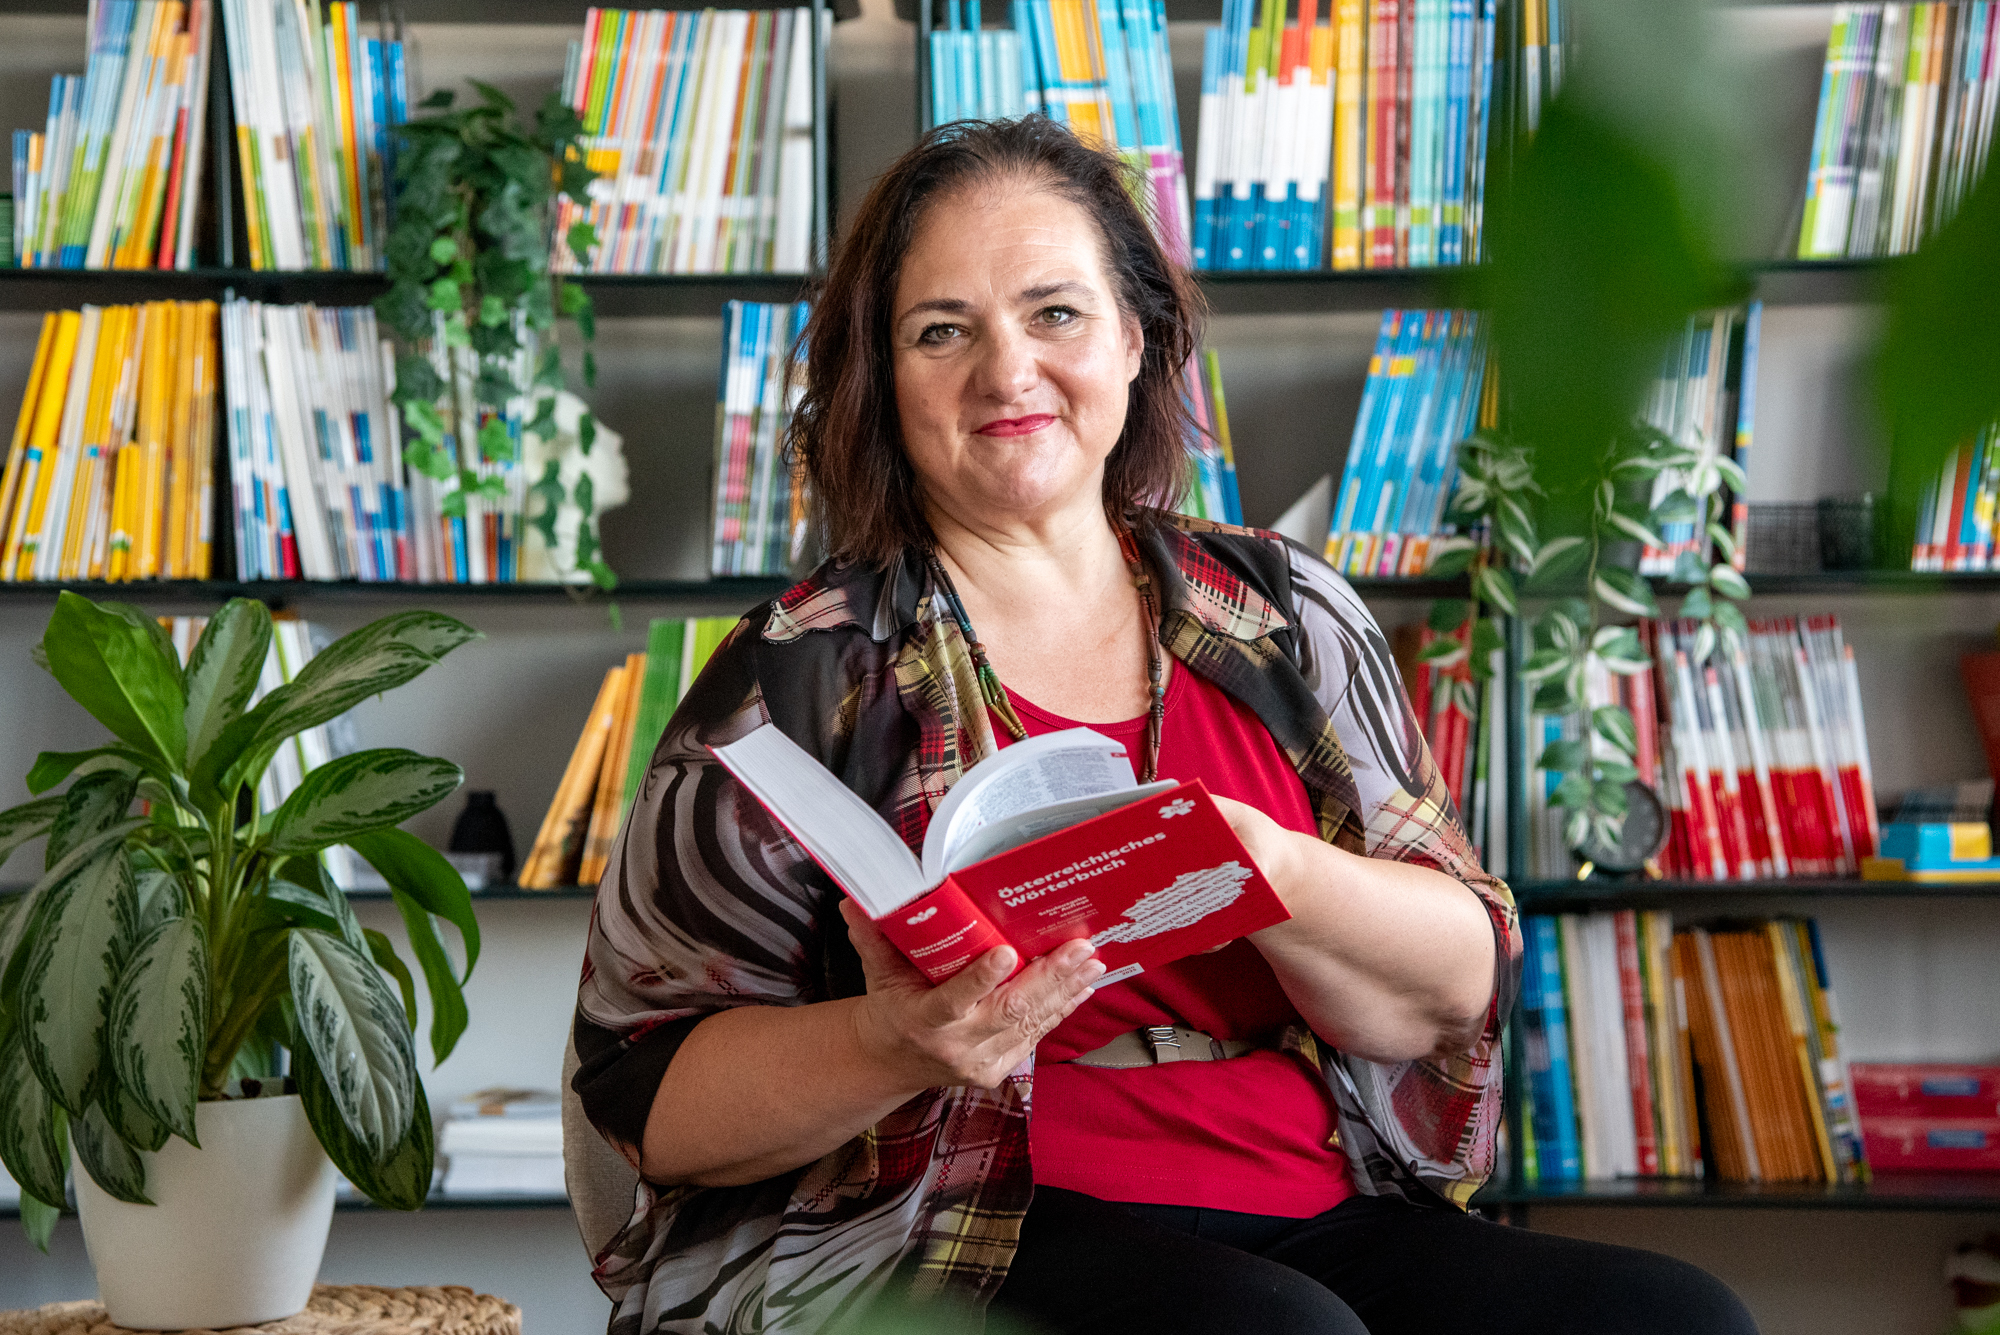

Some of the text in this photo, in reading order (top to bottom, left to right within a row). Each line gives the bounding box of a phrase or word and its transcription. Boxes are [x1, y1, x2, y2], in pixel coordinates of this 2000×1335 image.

[998, 832, 1166, 899] Österreichisches
[1004, 859, 1126, 908] Wörterbuch
[909, 919, 978, 955] Österreichisches
[913, 936, 964, 958] Wörterbuch
